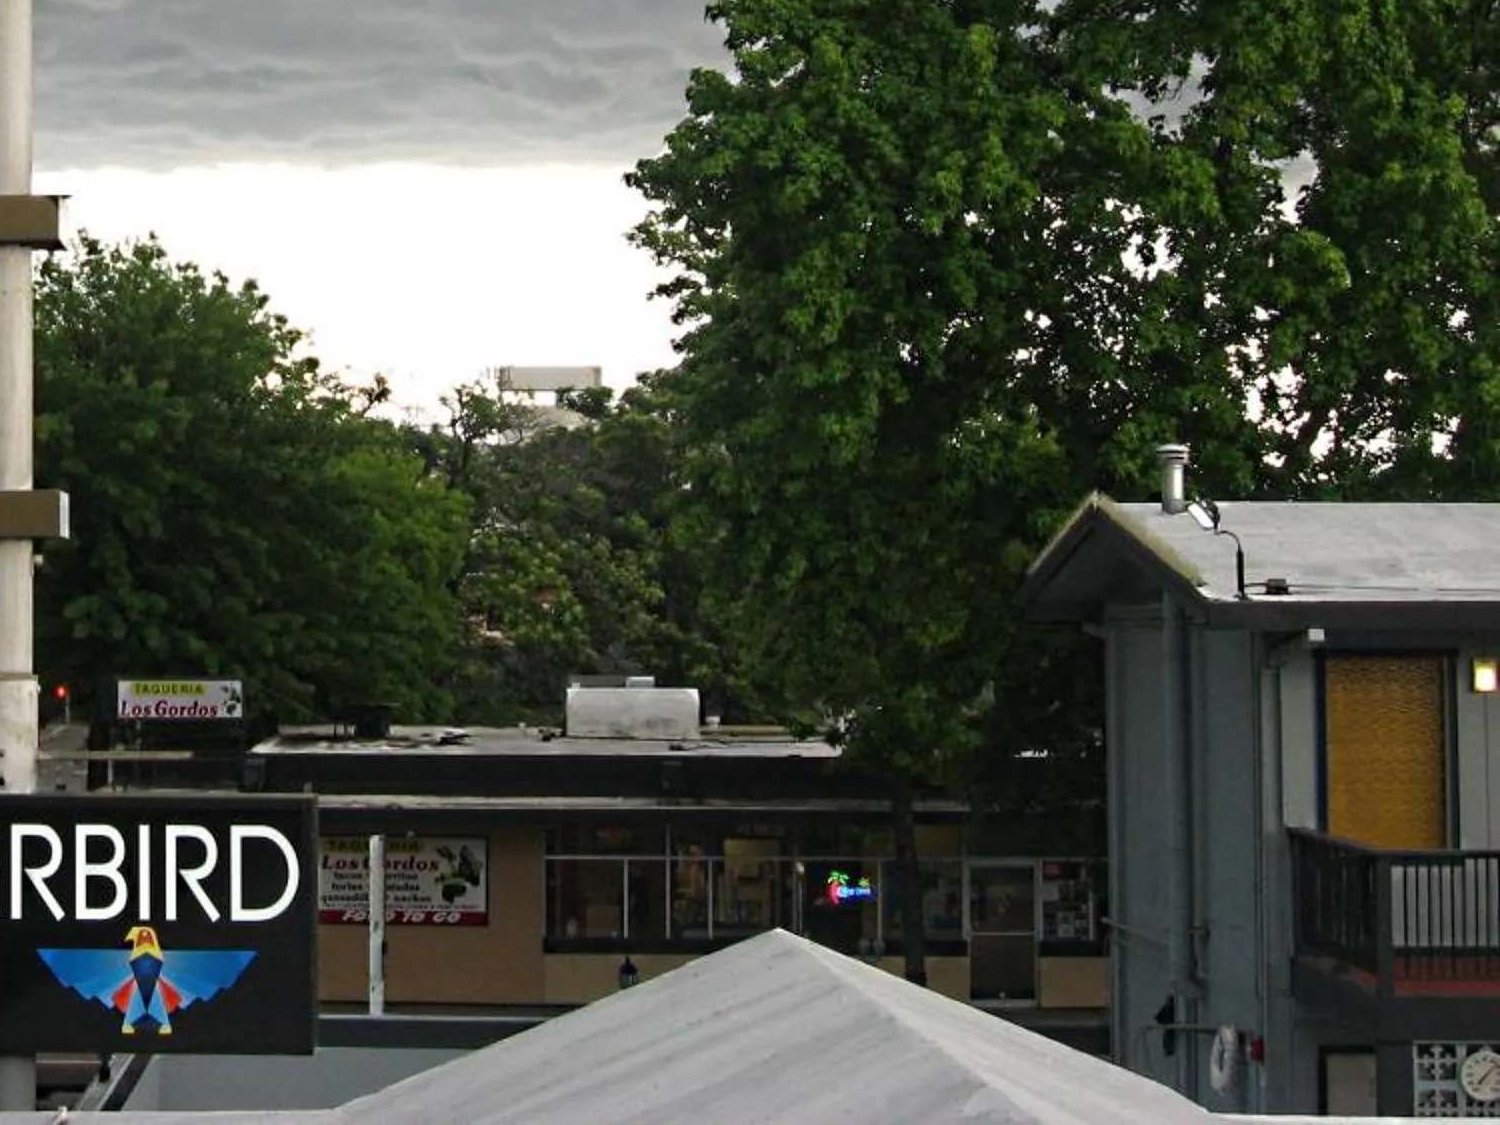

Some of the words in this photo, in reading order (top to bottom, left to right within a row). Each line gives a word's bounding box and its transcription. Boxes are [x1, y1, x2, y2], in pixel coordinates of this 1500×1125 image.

[133, 682, 206, 695] TAQUERIA
[121, 700, 151, 716] Los
[154, 700, 219, 716] Gordos
[323, 854, 359, 870] Los
